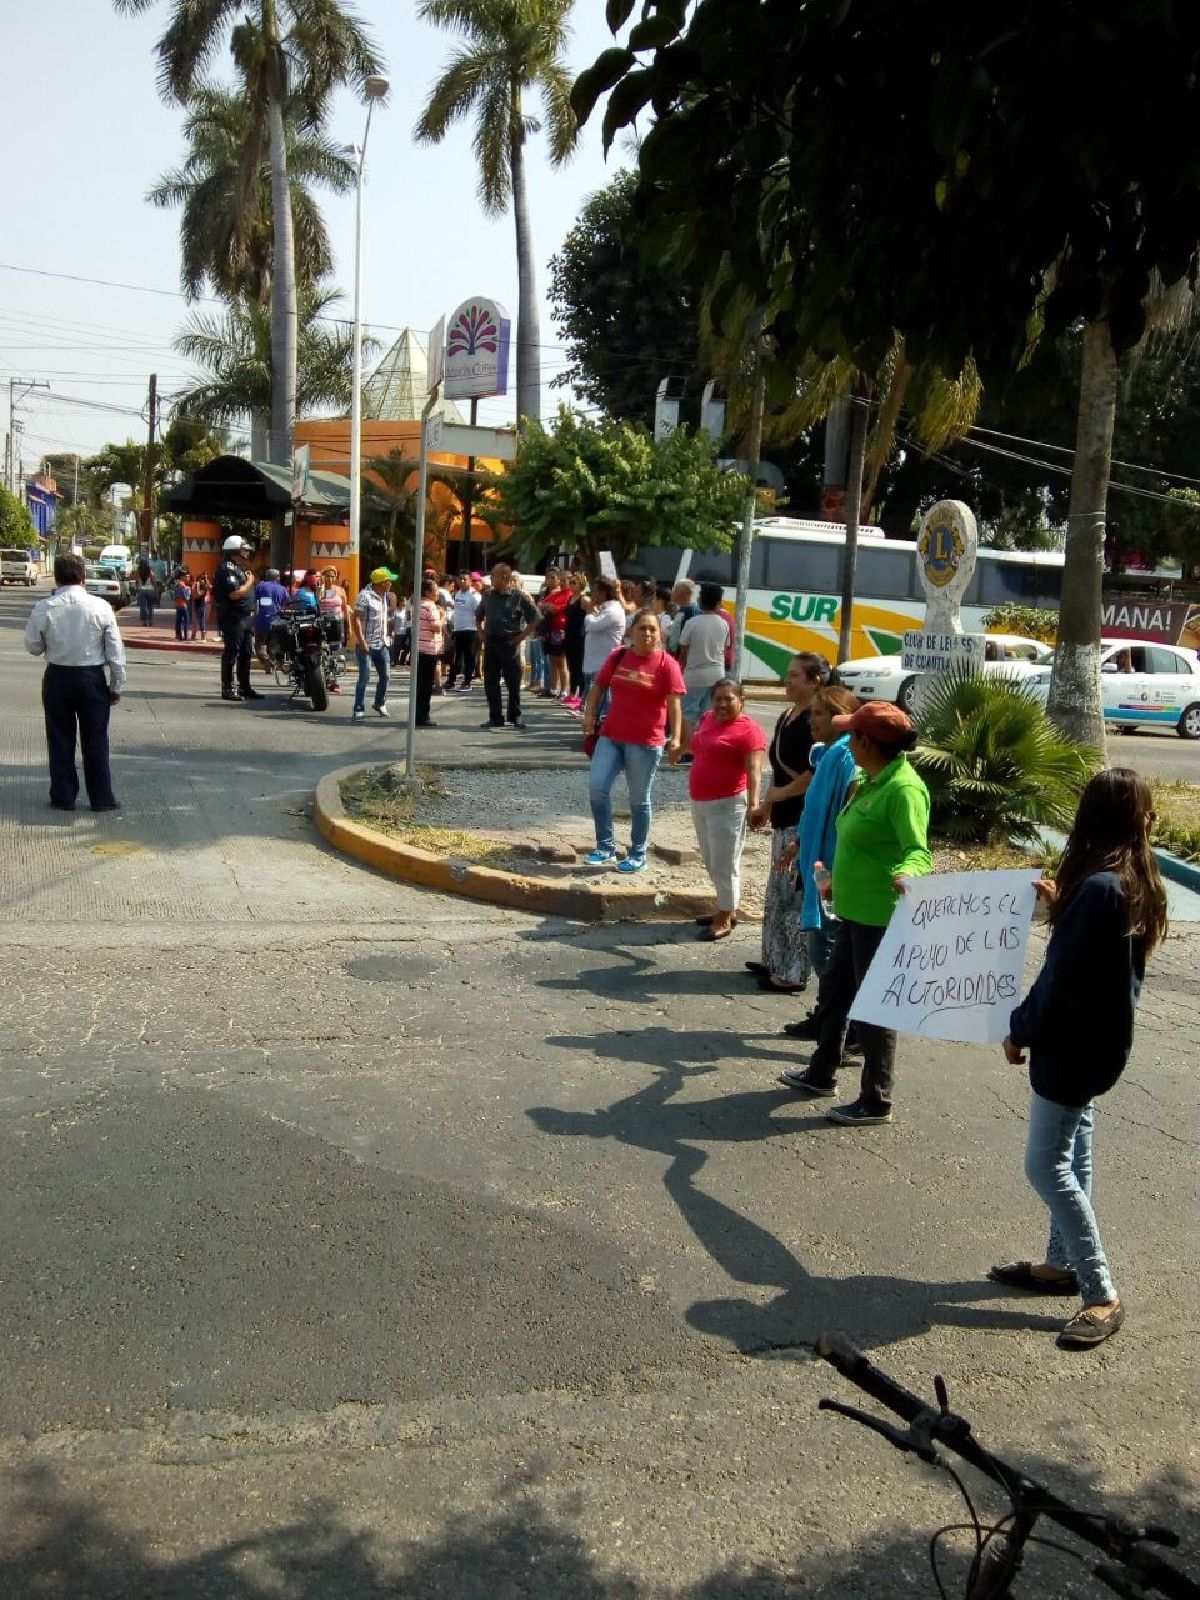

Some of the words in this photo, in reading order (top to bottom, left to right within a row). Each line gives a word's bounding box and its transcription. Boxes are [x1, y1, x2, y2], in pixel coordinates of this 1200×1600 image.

[935, 532, 948, 560] L
[769, 594, 838, 622] SUR
[904, 632, 923, 648] CLUB
[926, 634, 936, 650] DE
[904, 654, 914, 667] DE
[911, 893, 991, 929] QUEREMOS
[998, 894, 1021, 916] EL
[892, 944, 948, 970] APOYO
[955, 931, 975, 957] DE
[984, 926, 1020, 950] LAS
